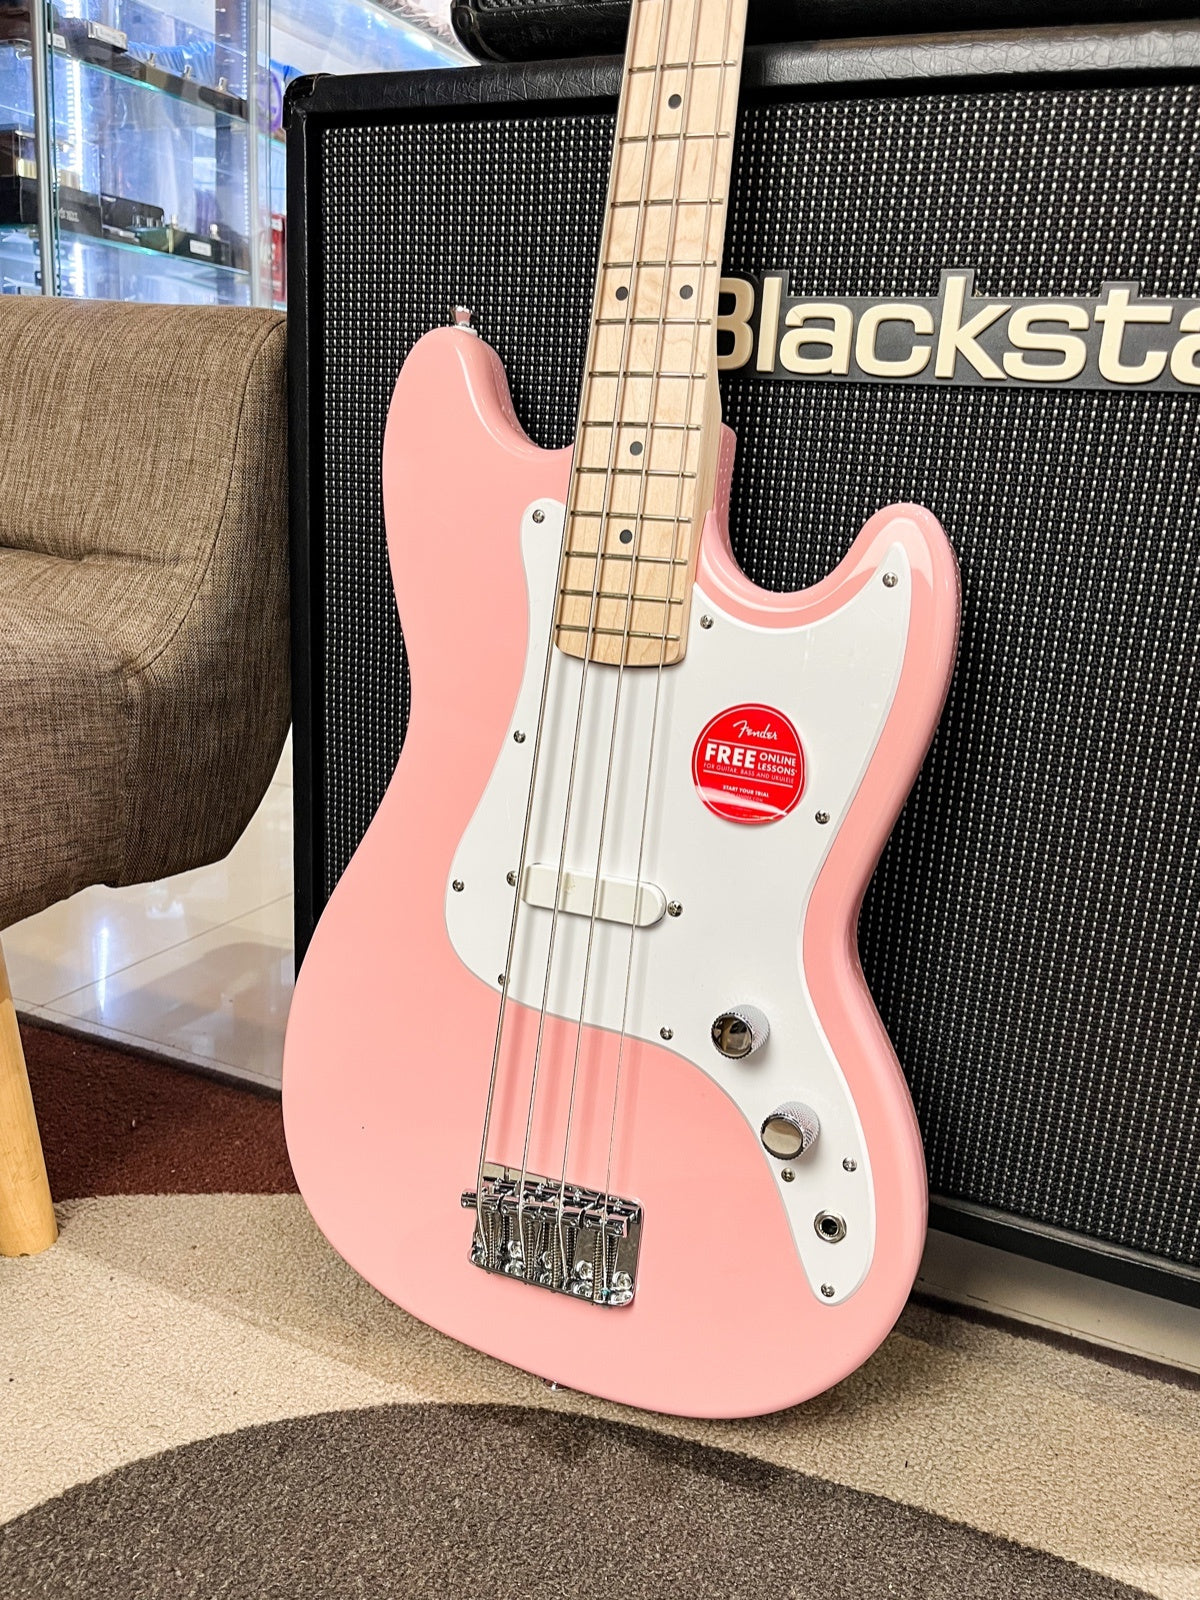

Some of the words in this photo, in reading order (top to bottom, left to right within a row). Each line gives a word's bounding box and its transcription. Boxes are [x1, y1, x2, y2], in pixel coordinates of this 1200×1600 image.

[733, 720, 777, 740] Fender
[705, 743, 757, 768] FREE
[759, 752, 797, 767] ONLINE
[703, 762, 715, 770] FOR
[740, 769, 755, 778] BASS
[756, 772, 770, 780] AND
[771, 774, 794, 784] UKULELE
[739, 787, 754, 795] YOUR
[755, 790, 769, 798] TRIAL
